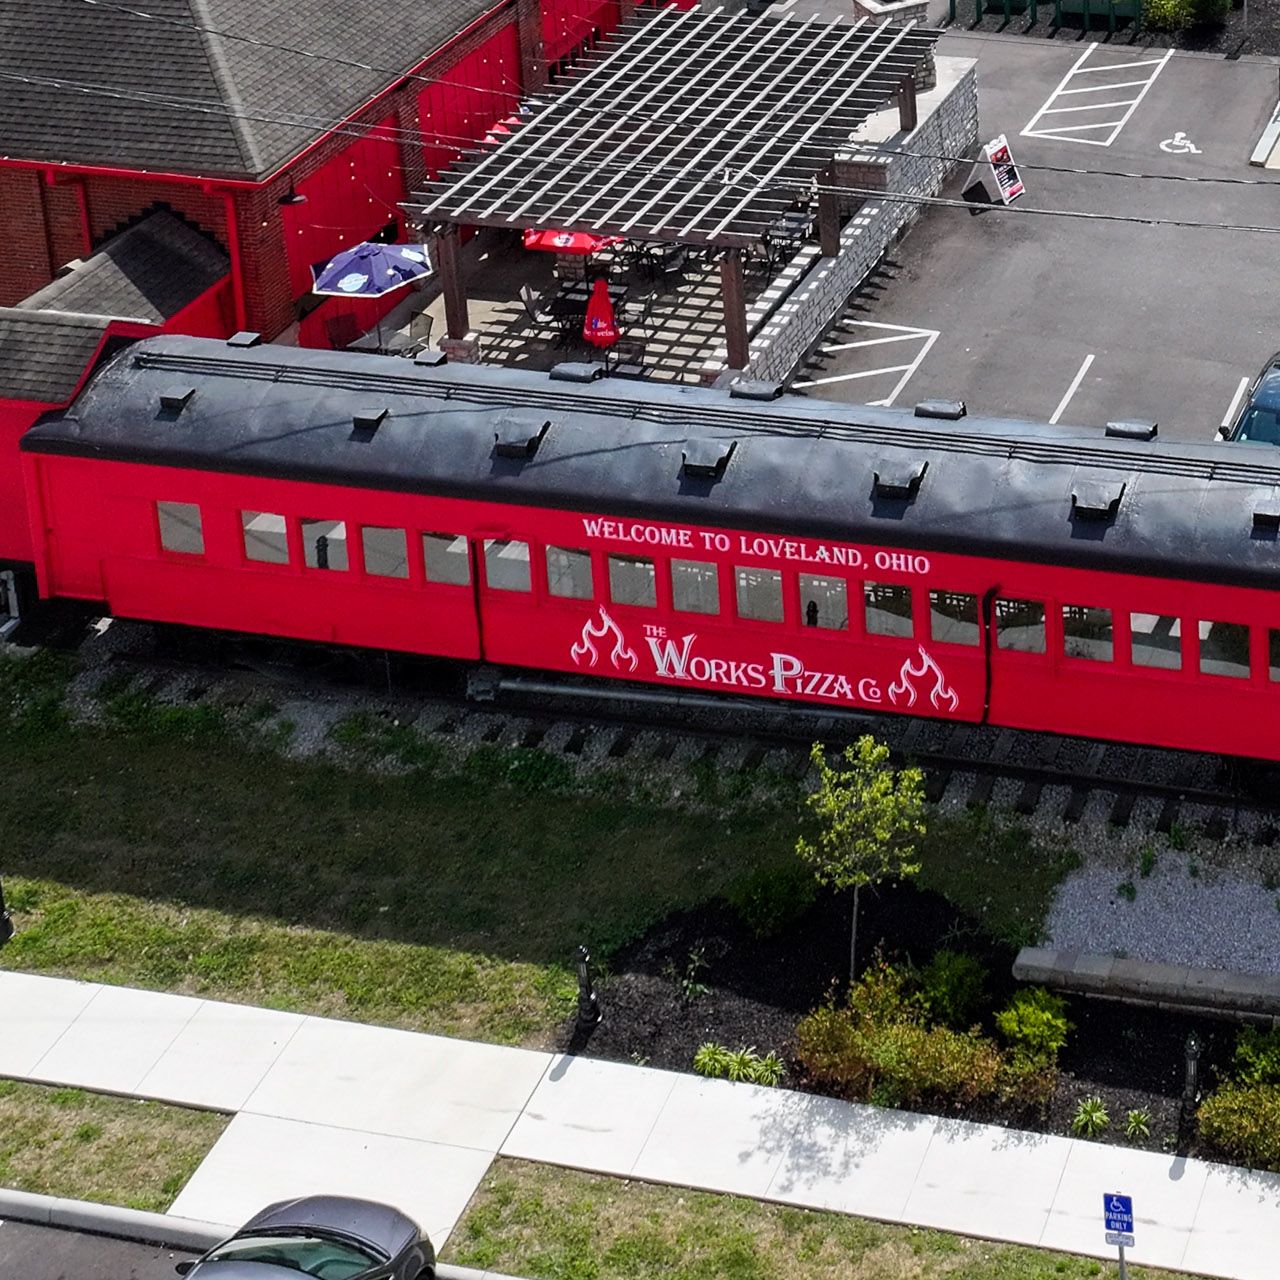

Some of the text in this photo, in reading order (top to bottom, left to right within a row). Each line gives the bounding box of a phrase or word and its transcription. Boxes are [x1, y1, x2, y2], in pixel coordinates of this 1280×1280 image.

[582, 517, 930, 574] WELCOME TO LOVELAND, OHIO
[642, 624, 667, 638] THE
[644, 633, 767, 688] WORKS
[1105, 1211, 1132, 1223] PARKING
[1110, 1220, 1127, 1231] ONLY
